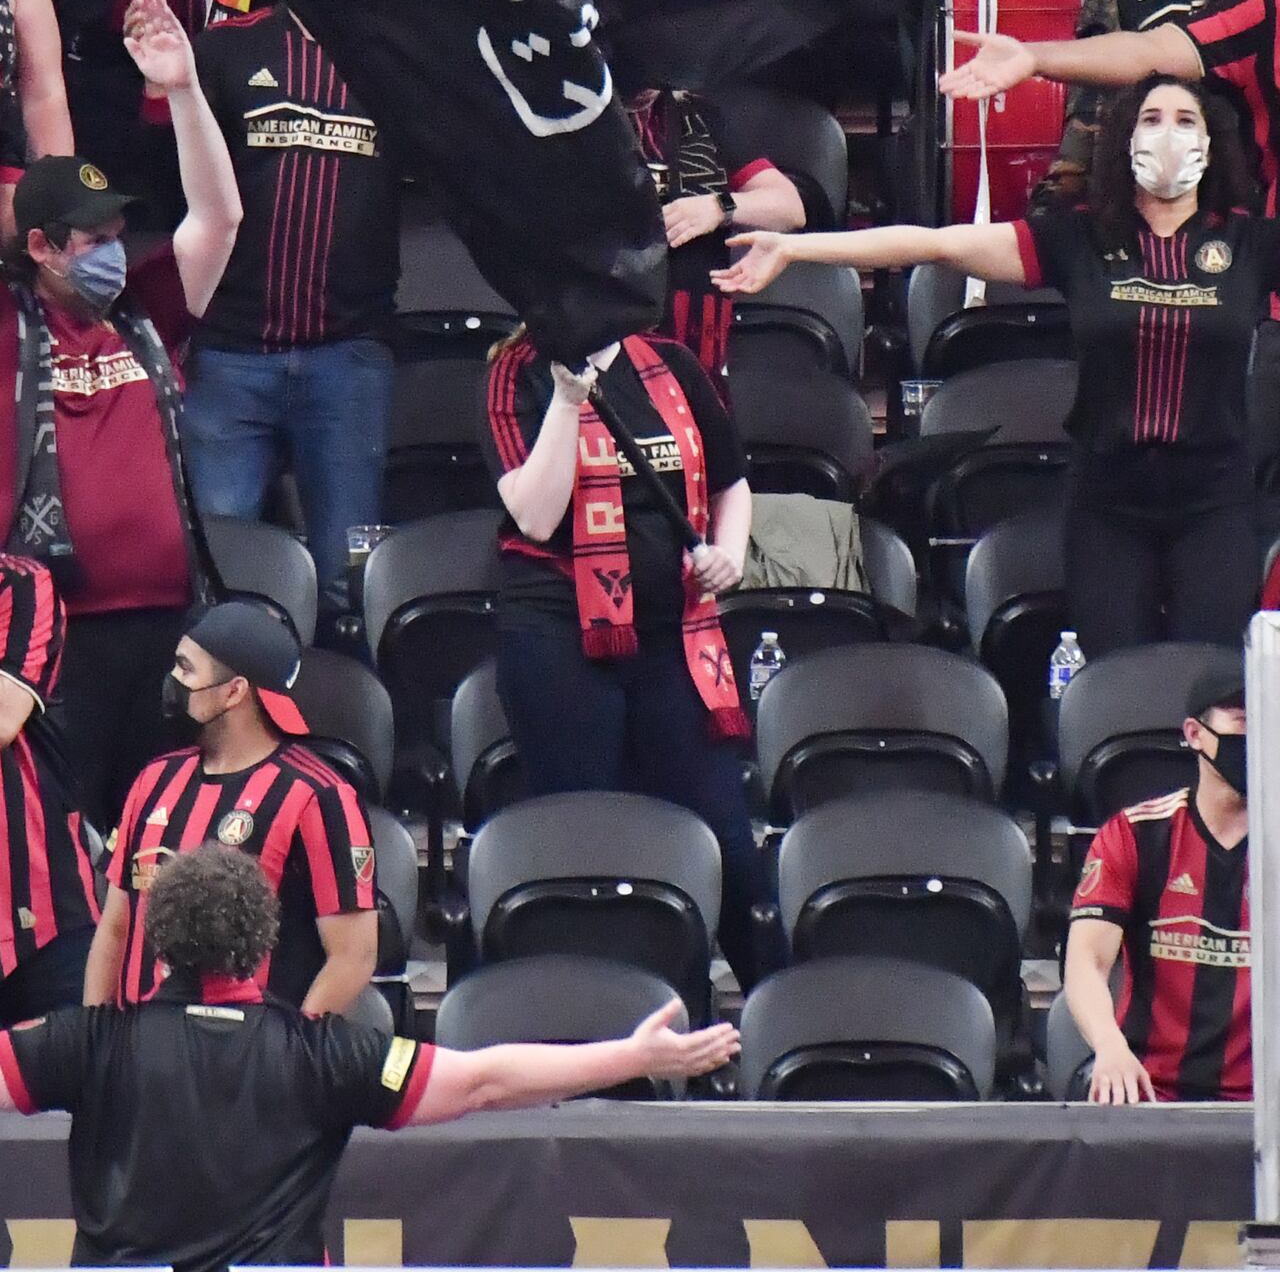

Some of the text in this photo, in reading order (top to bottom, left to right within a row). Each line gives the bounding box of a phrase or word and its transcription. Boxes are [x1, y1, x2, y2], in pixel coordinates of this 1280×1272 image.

[247, 118, 378, 142] AMERICAN FAMILY
[256, 134, 365, 151] INSURANCE
[1152, 930, 1227, 949] AMERICAN
[1158, 944, 1248, 964] INSURAN
